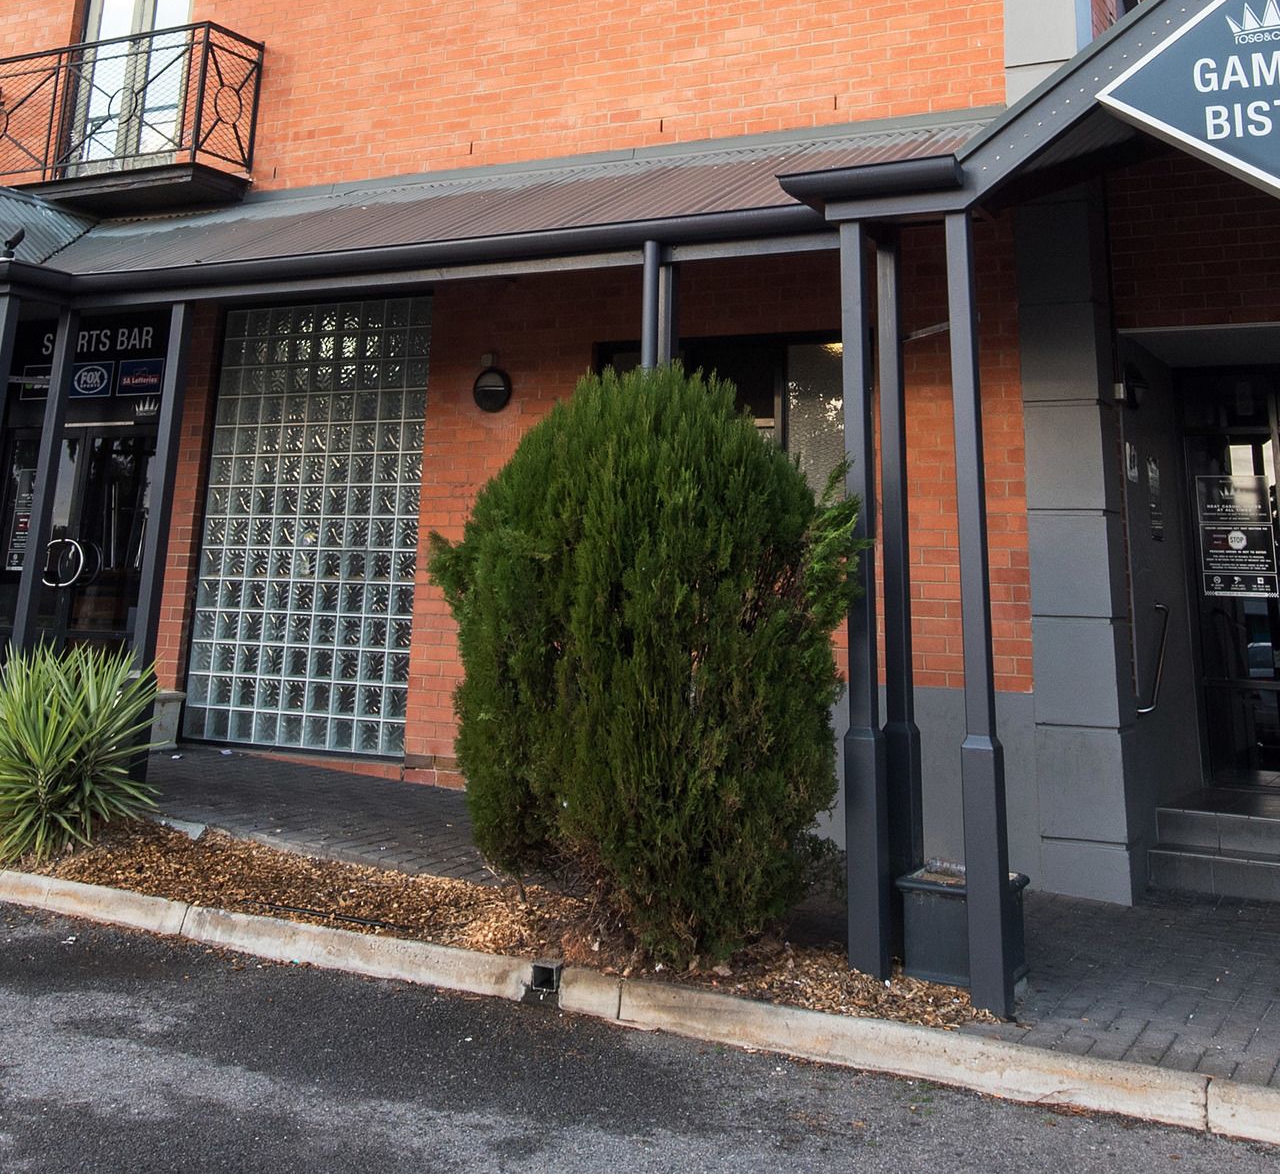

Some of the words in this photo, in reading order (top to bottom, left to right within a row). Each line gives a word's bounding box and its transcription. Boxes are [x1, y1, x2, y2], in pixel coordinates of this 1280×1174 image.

[42, 329, 111, 355] SRTS
[116, 326, 153, 351] BAR
[80, 371, 102, 384] FOX
[1229, 536, 1244, 544] STOP
